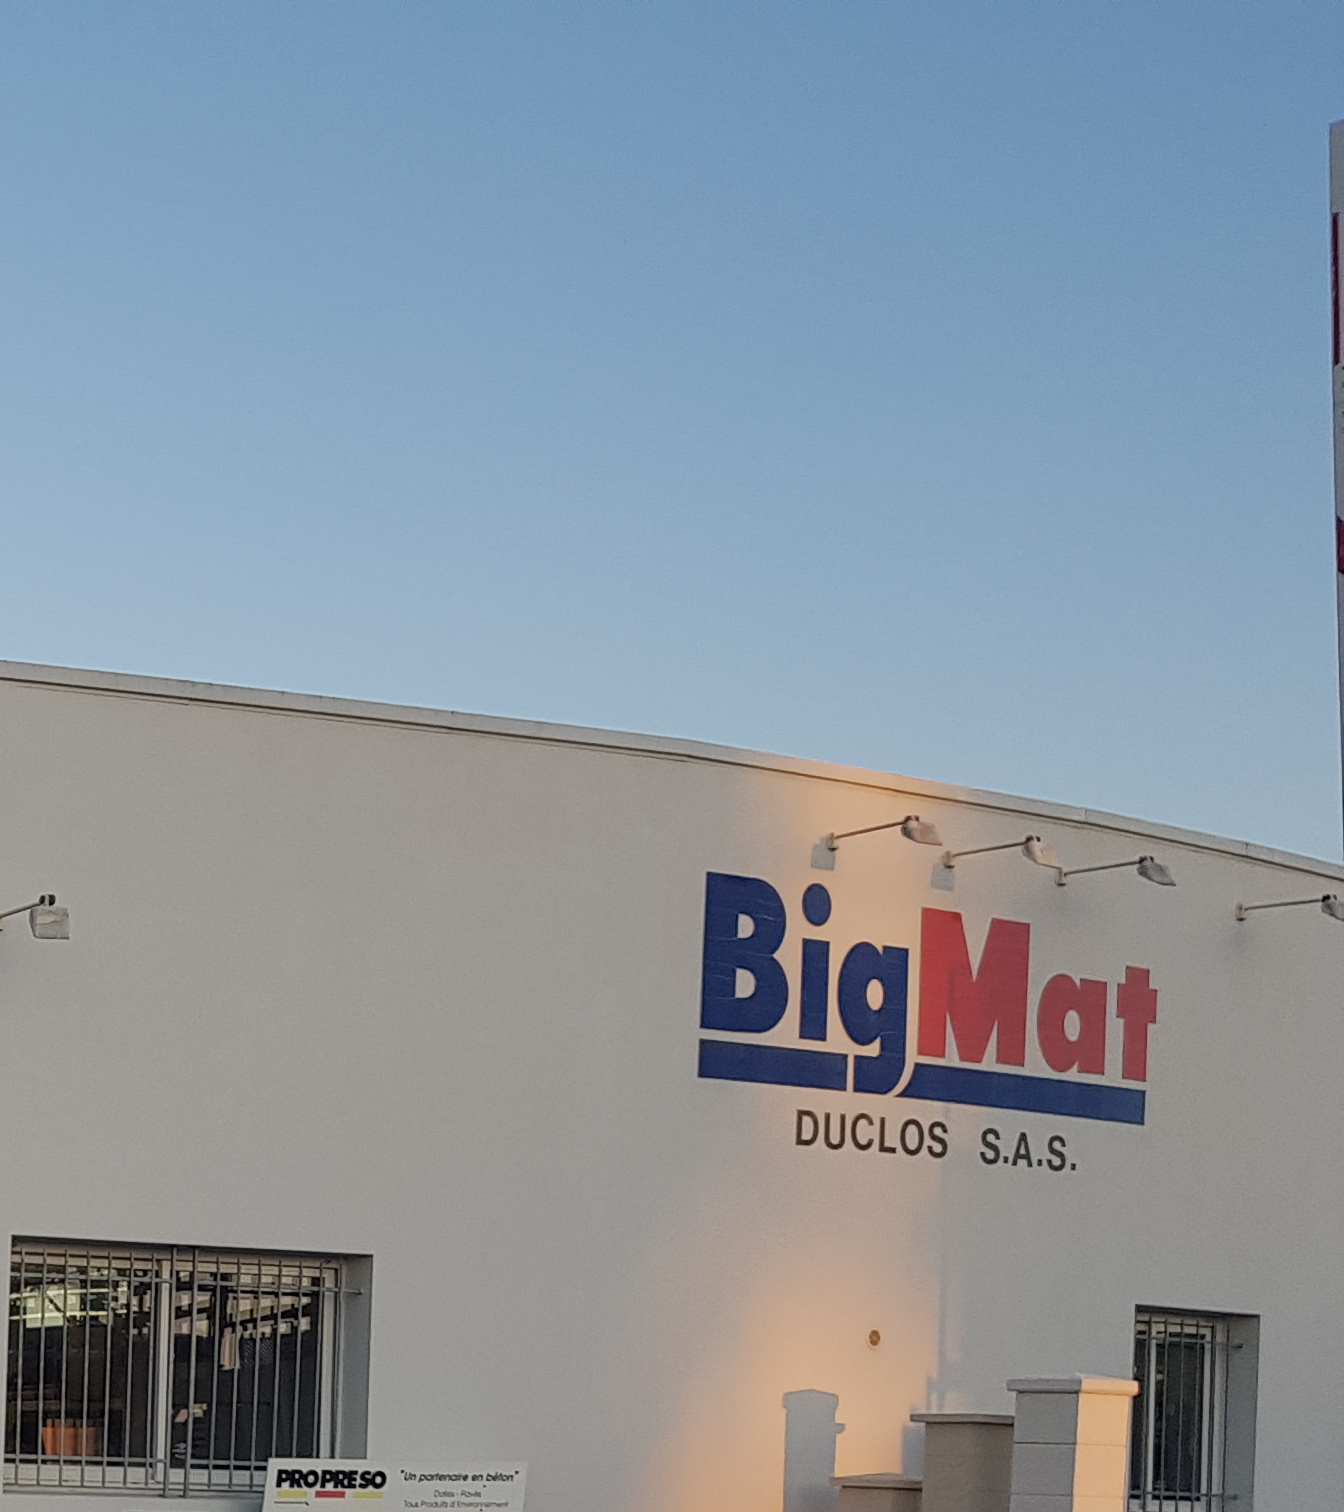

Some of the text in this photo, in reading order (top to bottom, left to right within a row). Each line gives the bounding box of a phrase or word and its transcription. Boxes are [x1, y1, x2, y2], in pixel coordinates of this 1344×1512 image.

[794, 1108, 1077, 1171] DUCLOS S.A.S.
[275, 1469, 387, 1489] PROPRESO
